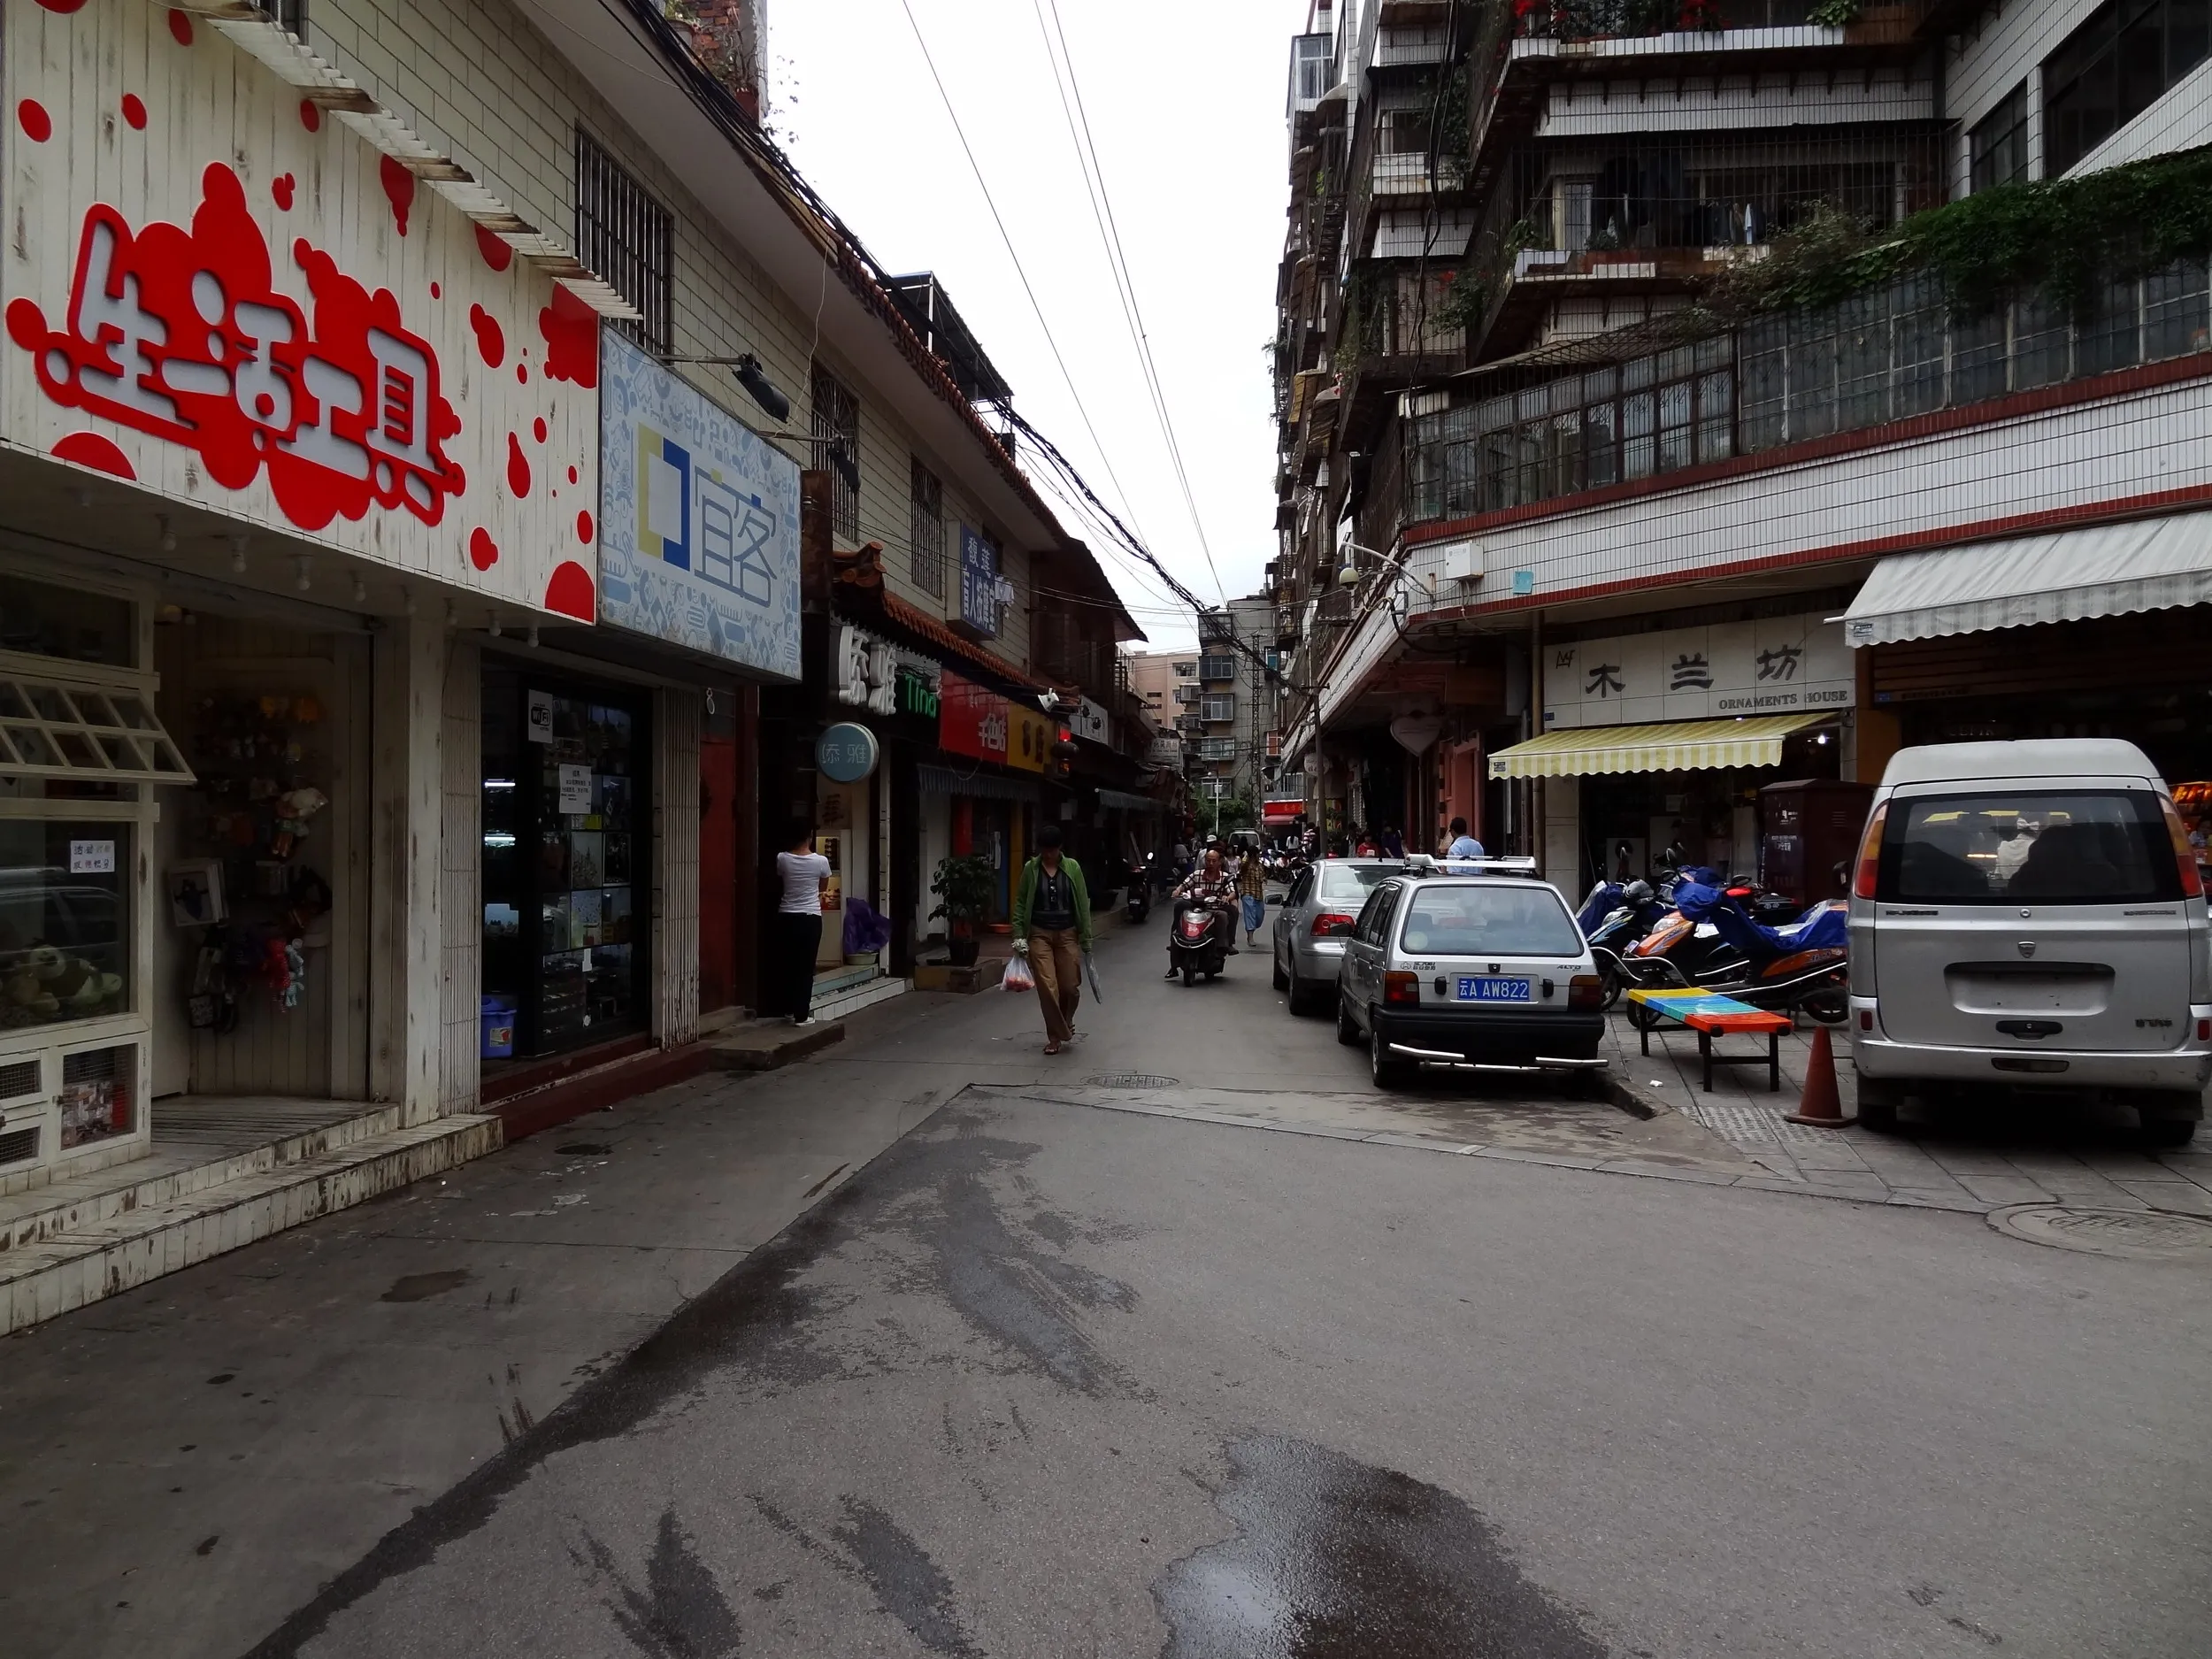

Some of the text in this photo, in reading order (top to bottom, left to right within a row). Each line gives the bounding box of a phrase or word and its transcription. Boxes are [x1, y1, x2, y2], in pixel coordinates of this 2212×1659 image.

[1585, 644, 1803, 699] 木兰坊
[1718, 690, 1848, 710] ORNAMENTS HOUSE
[821, 743, 867, 764] 添雅
[1460, 980, 1528, 998] 云A AW822
